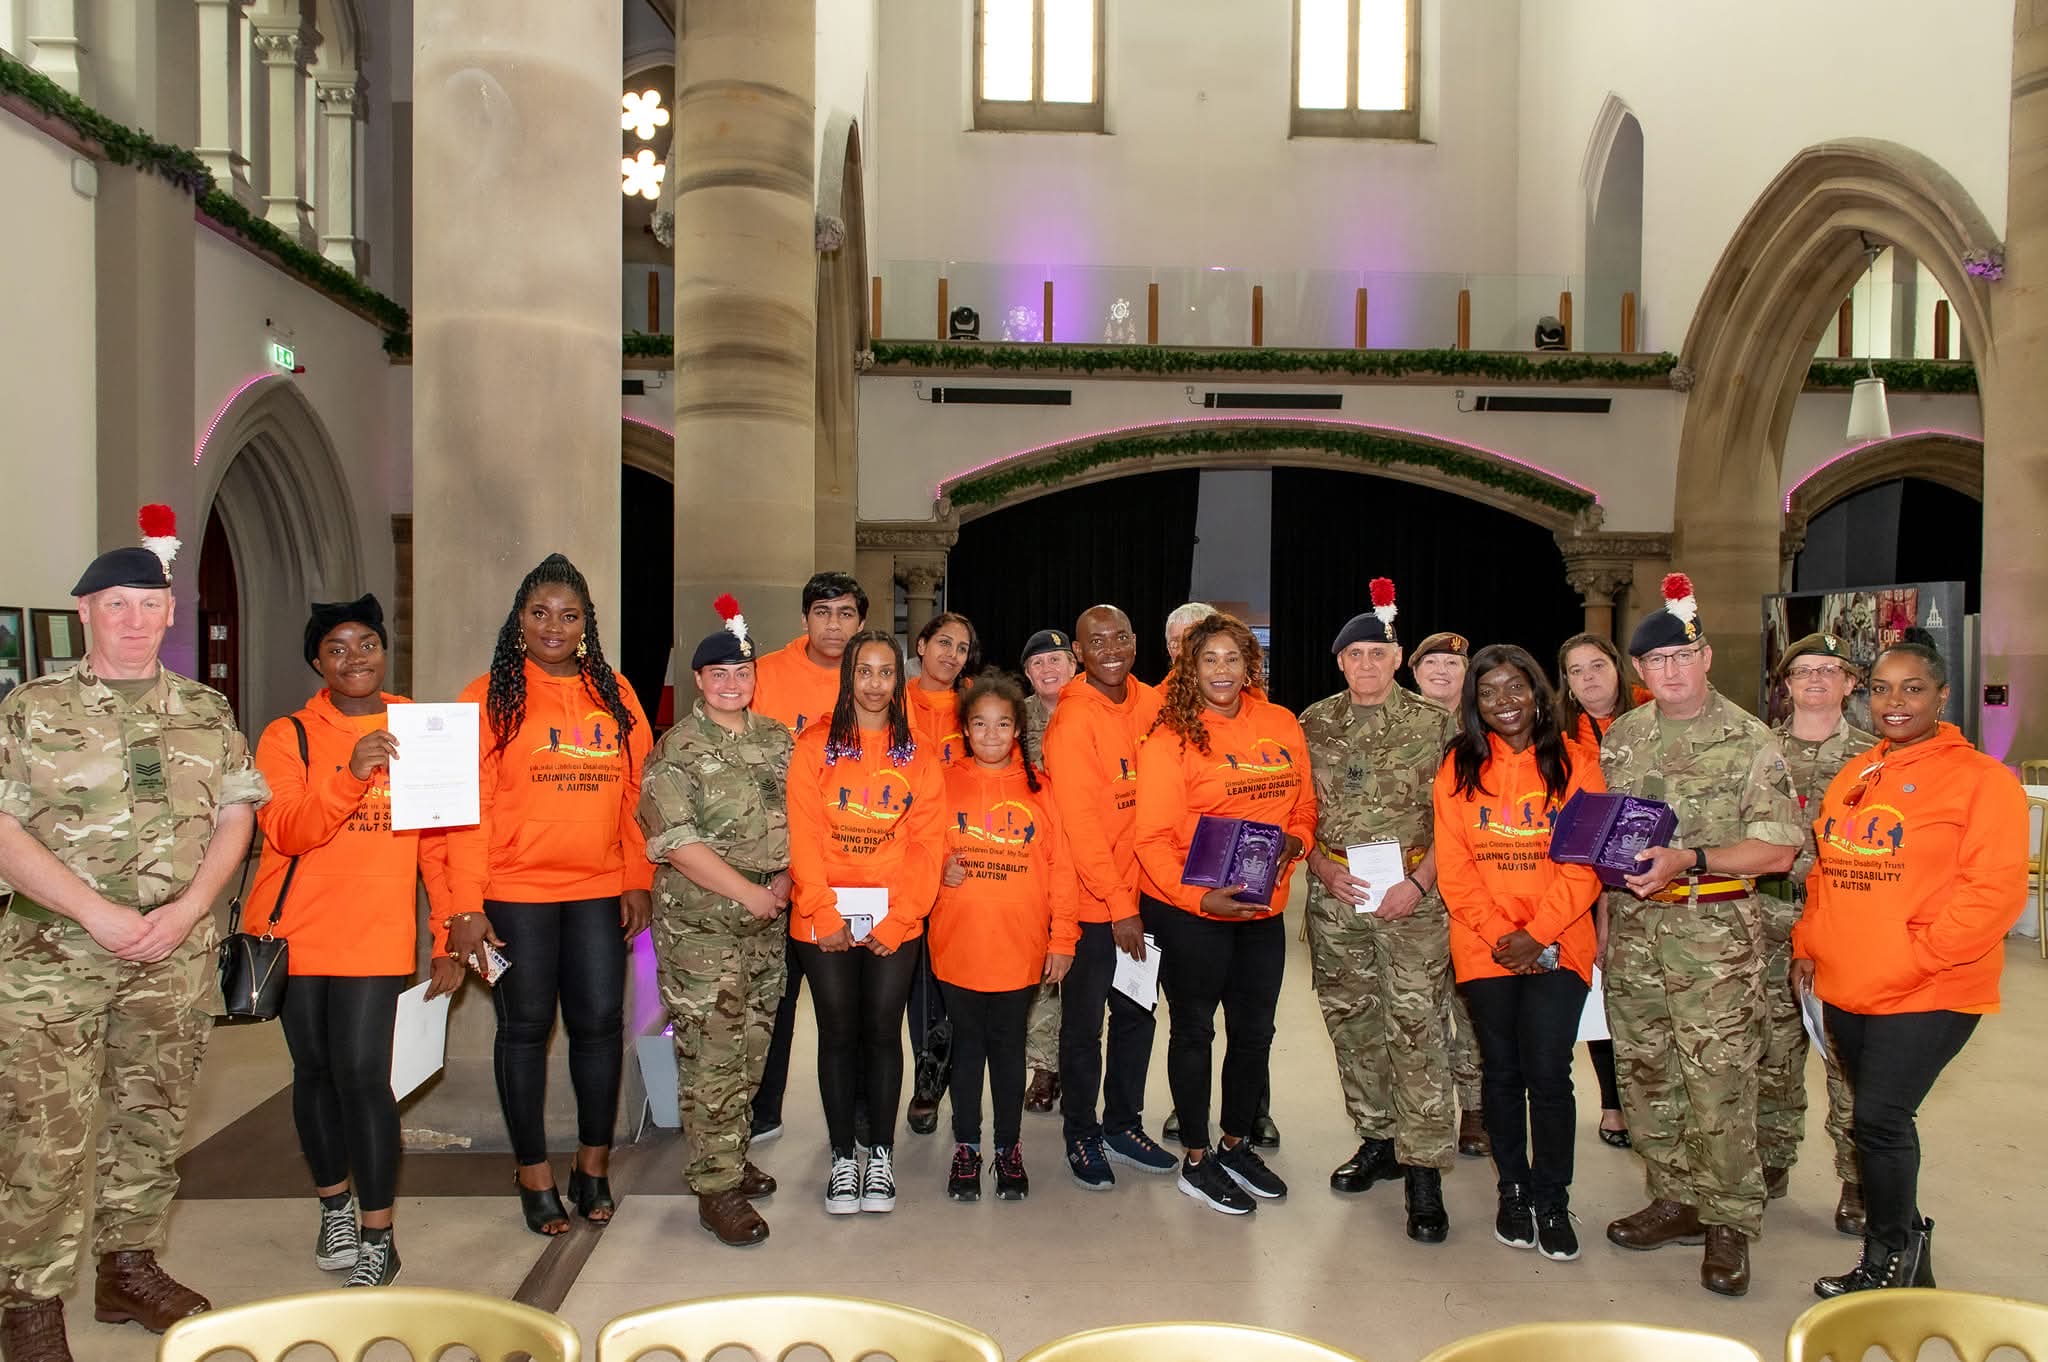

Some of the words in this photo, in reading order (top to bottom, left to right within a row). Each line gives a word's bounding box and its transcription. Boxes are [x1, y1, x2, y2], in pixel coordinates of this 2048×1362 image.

[1878, 629, 1901, 643] LOVE
[567, 783, 599, 792] AUTISM
[1227, 783, 1267, 796] LEARNING
[1258, 790, 1286, 799] AUTISM
[843, 844, 849, 852] &
[987, 861, 1028, 873] DISABILITY
[968, 870, 974, 878] &
[976, 870, 1008, 881] AUTISM
[1850, 869, 1901, 882] DISABILITY
[1833, 879, 1839, 888] &
[1840, 881, 1871, 891] AUTISM
